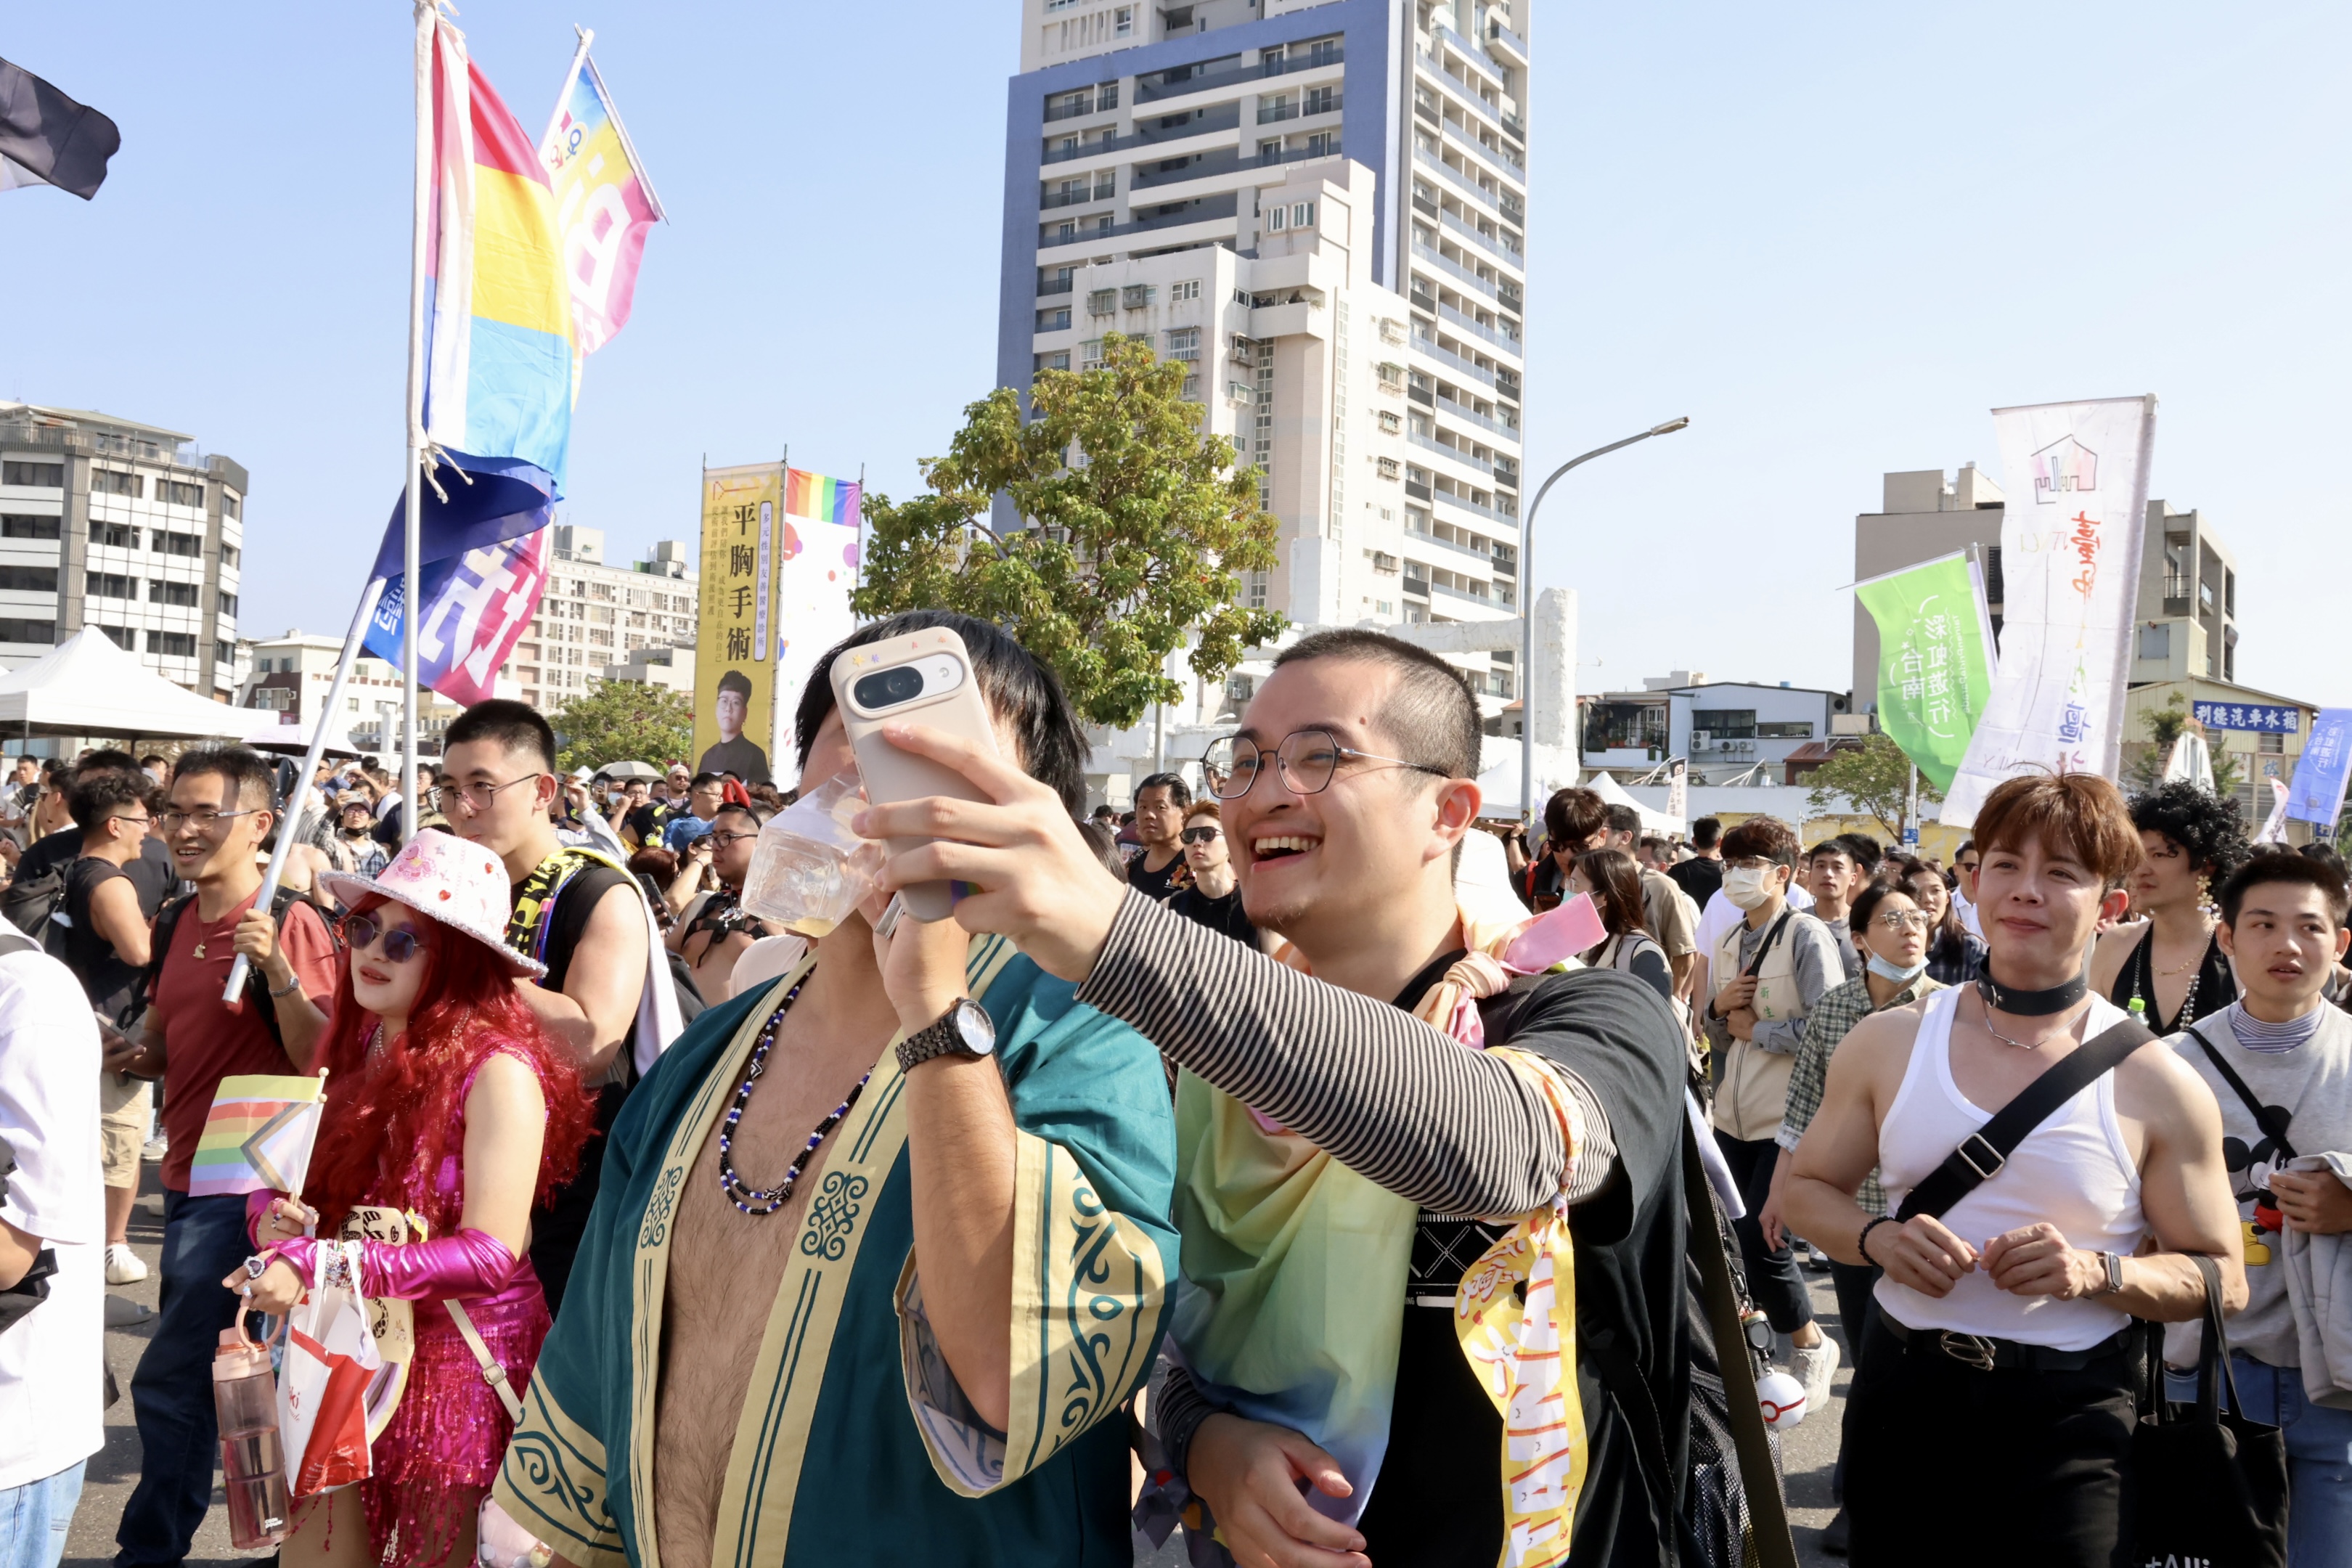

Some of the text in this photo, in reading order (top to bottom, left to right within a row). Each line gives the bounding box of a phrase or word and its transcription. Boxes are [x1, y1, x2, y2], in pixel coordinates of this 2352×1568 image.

[727, 502, 756, 661] 平胸手術
[757, 513, 769, 648] 多元性別友善醫療診所
[2195, 705, 2298, 730] 利德汽車水箱
